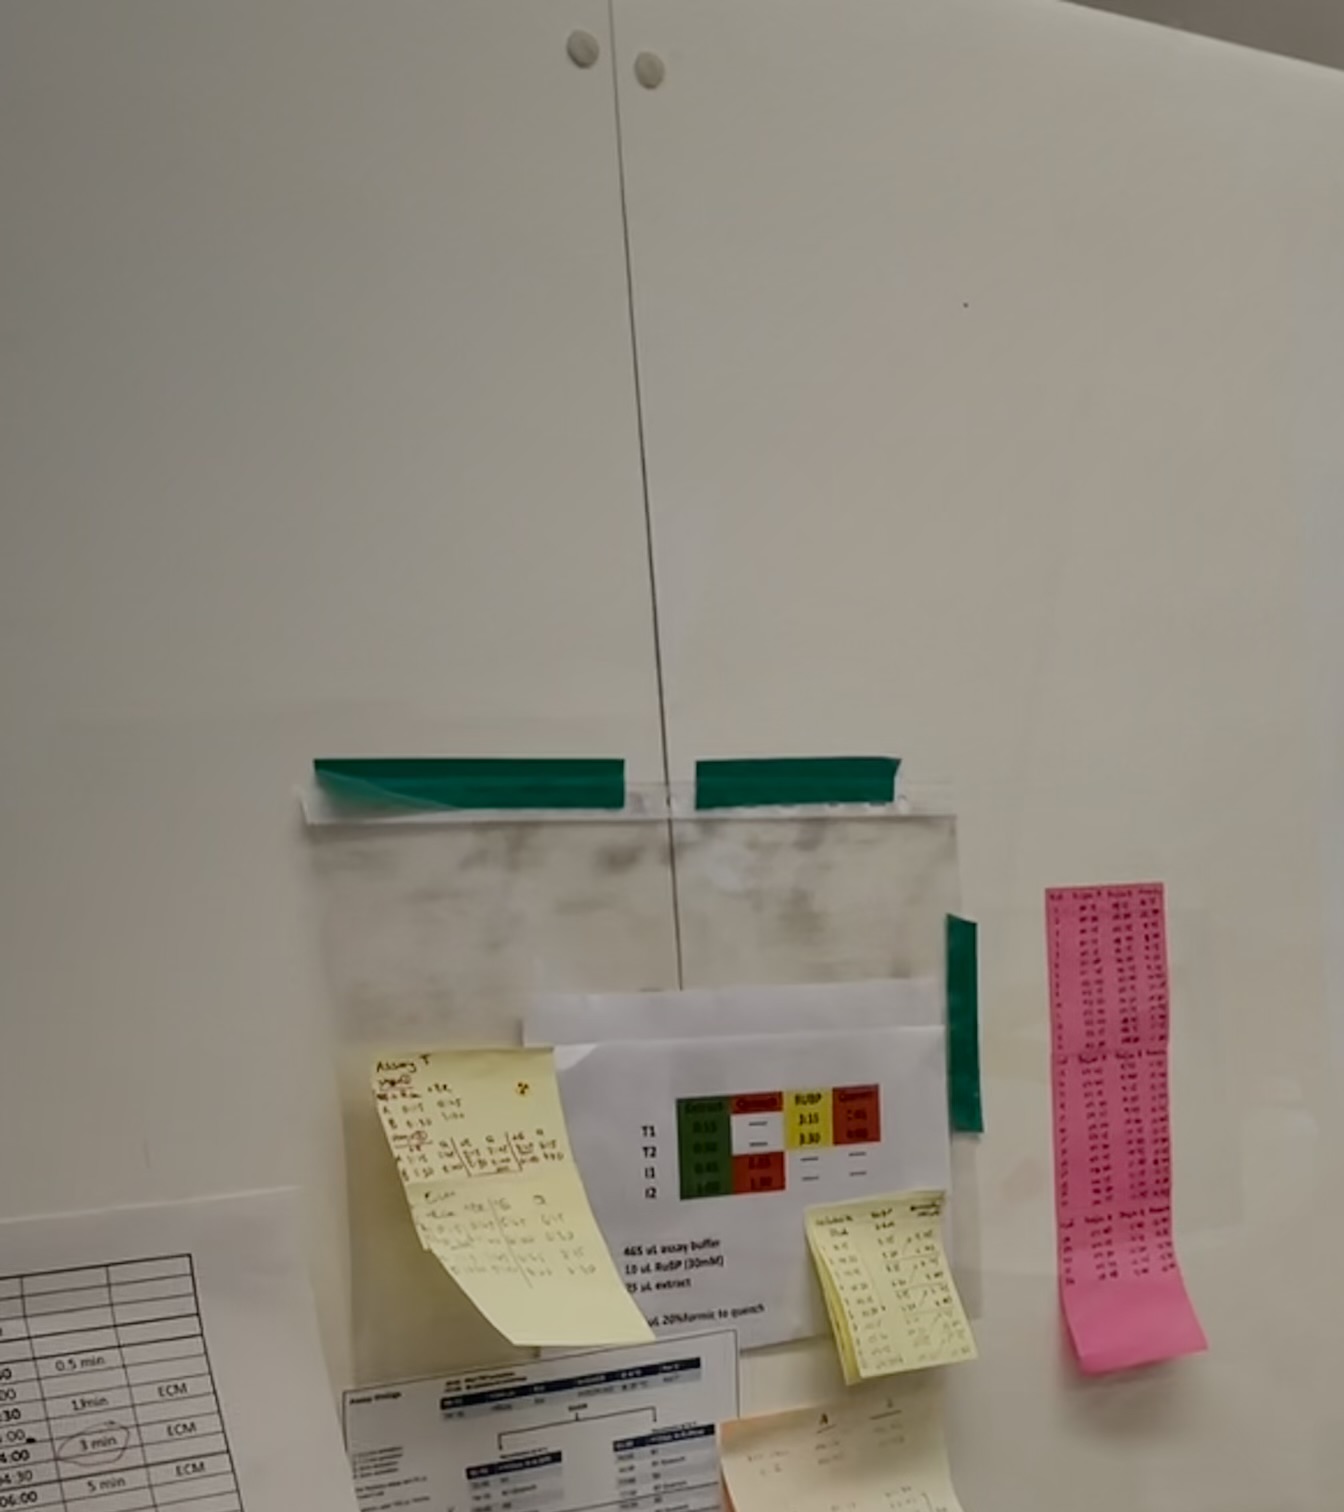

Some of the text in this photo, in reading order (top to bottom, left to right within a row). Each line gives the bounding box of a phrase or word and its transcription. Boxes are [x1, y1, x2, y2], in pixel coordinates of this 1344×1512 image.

[641, 1125, 656, 1138] T1
[660, 1243, 688, 1255] assay
[691, 1238, 721, 1251] buffer
[655, 1278, 692, 1291] extract
[54, 1354, 106, 1373] 0.5 min
[157, 1382, 188, 1398] ECM
[91, 1434, 118, 1450] min
[166, 1421, 198, 1438] ECM
[175, 1461, 207, 1478] ECM
[99, 1475, 127, 1491] min
